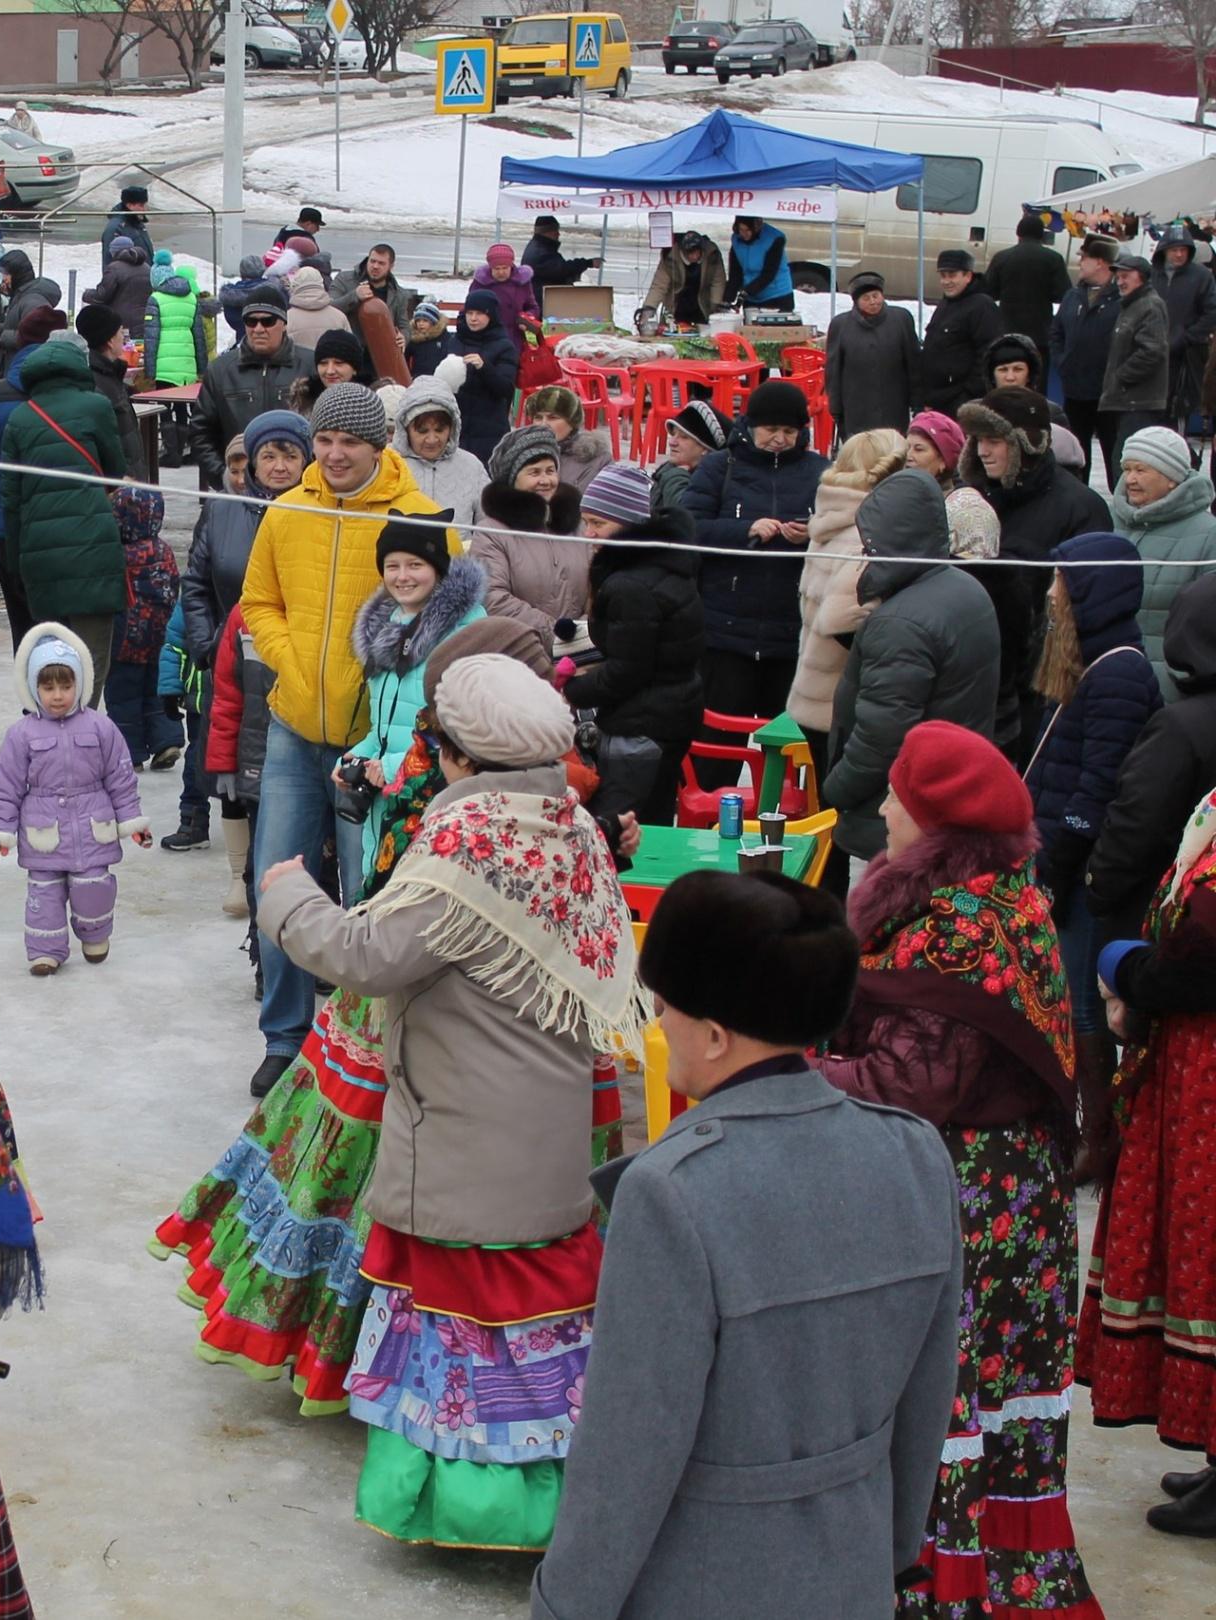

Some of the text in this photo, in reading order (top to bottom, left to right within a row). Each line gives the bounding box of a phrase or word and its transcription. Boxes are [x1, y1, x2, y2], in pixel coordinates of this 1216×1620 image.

[524, 190, 822, 216] кафе ВЛАДИМИР кафе
